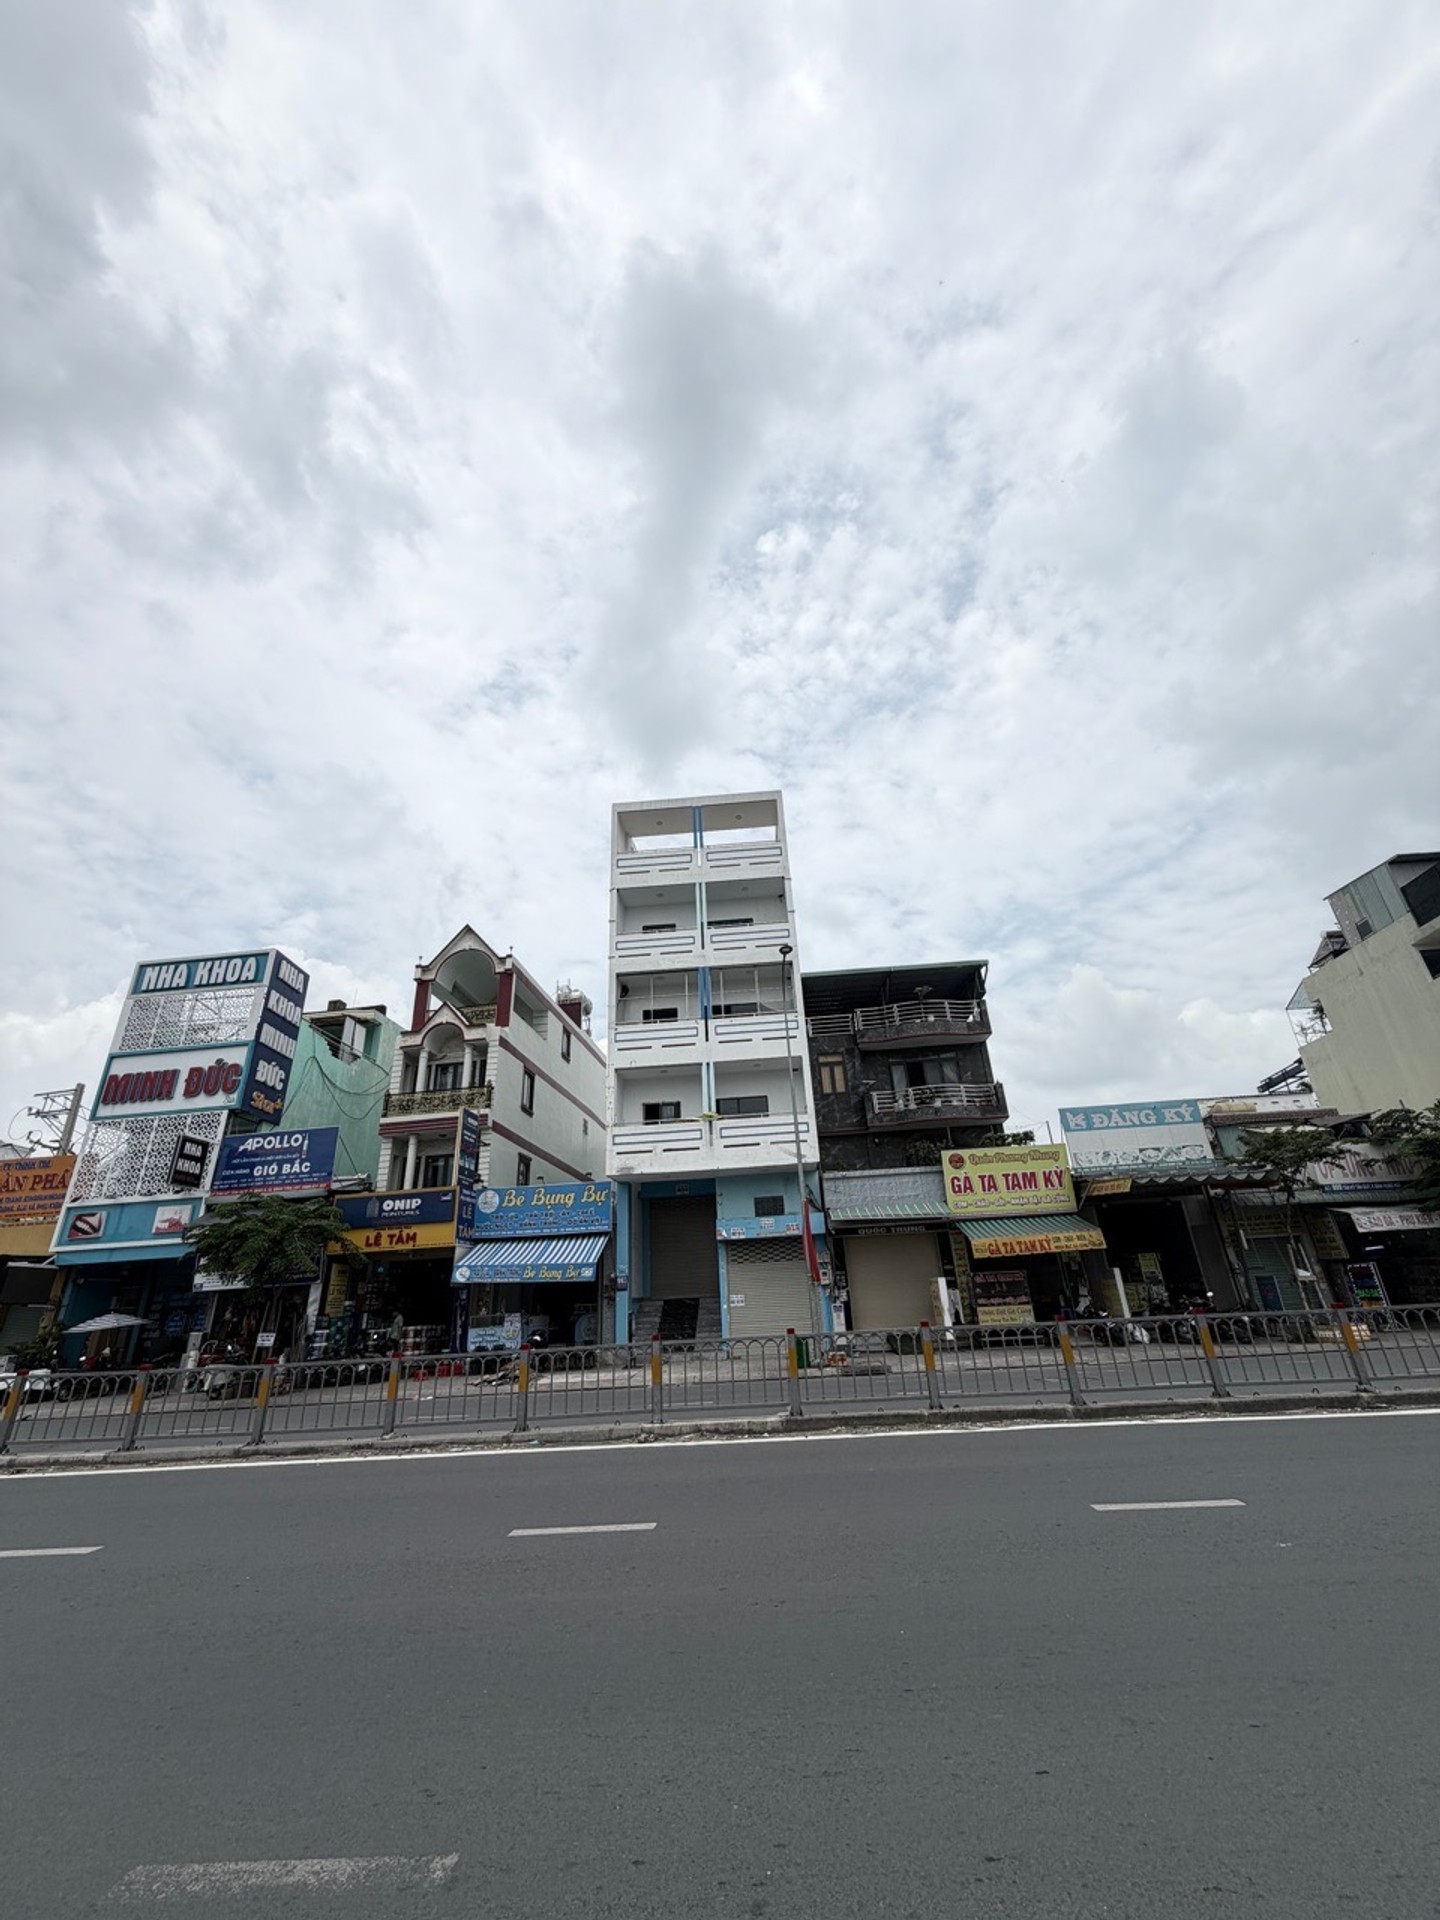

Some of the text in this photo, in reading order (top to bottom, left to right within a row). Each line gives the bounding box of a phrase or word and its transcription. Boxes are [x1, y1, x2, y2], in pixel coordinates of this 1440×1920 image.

[141, 957, 257, 990] NHA KHOA
[278, 959, 304, 993] NHA
[267, 990, 301, 1027] KHOA
[259, 1023, 296, 1059] MINH
[101, 1058, 242, 1105] MINH ĐỨC
[255, 1060, 285, 1090] ĐỨC
[1090, 1109, 1157, 1128] ĐĂNG
[1162, 1103, 1194, 1122] KÝ
[183, 1142, 202, 1157] NHA
[239, 1133, 303, 1151] APOLLO
[176, 1158, 201, 1175] KHOA
[253, 1161, 278, 1176] GIÓ
[282, 1159, 311, 1174] BẮC
[29, 1168, 71, 1190] PHÁ
[950, 1166, 1064, 1194] GÀ TA TAM KỲ
[382, 1198, 421, 1211] ONIP
[502, 1185, 608, 1208] Bé Bụng Bự
[365, 1232, 382, 1247] LÊ
[988, 1239, 1001, 1255] GÀ
[1002, 1242, 1016, 1254] TA
[1016, 1239, 1038, 1253] TAM
